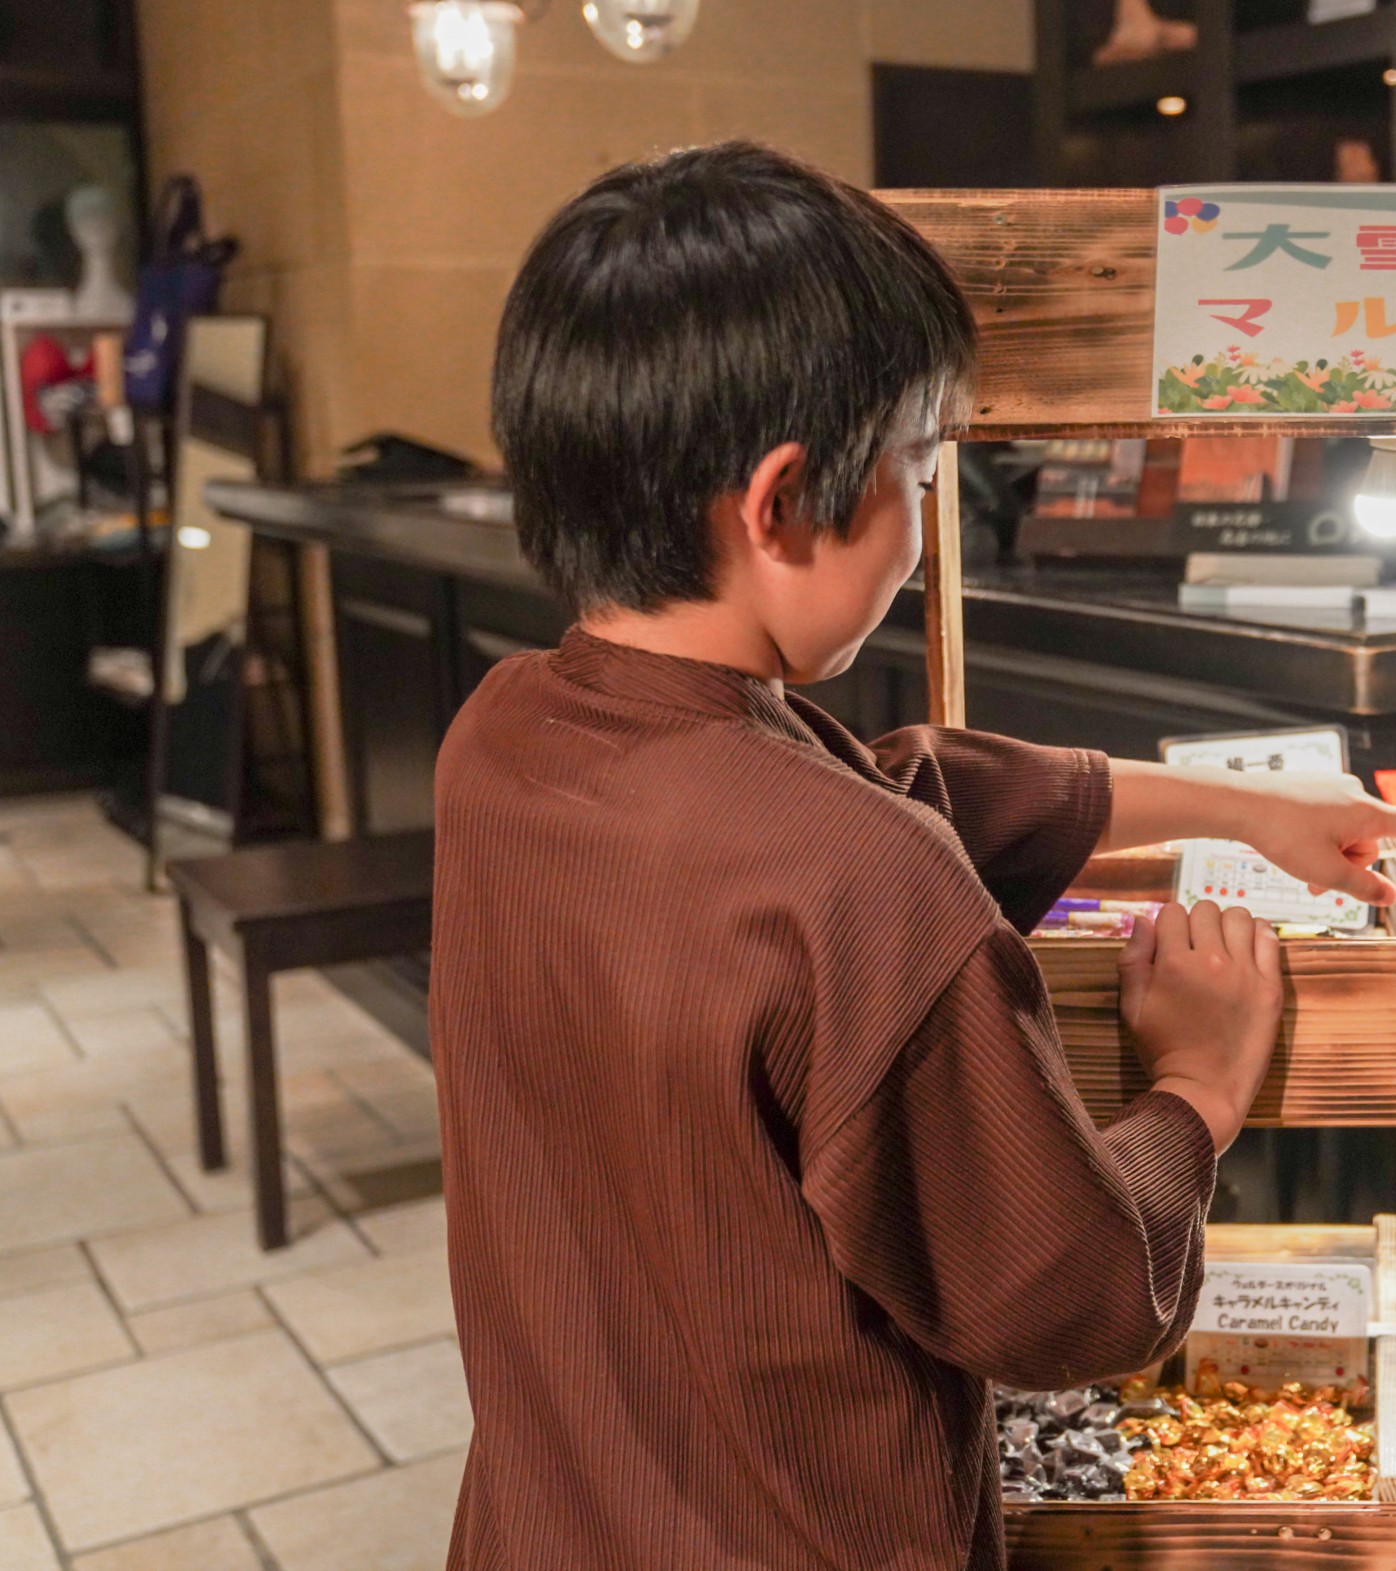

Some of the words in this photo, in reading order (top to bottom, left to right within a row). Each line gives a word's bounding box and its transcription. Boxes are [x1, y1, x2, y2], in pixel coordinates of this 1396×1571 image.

[1213, 1294, 1341, 1311] キャラメルキャンディ
[1217, 1313, 1283, 1330] Caramel
[1288, 1315, 1340, 1333] Candy
